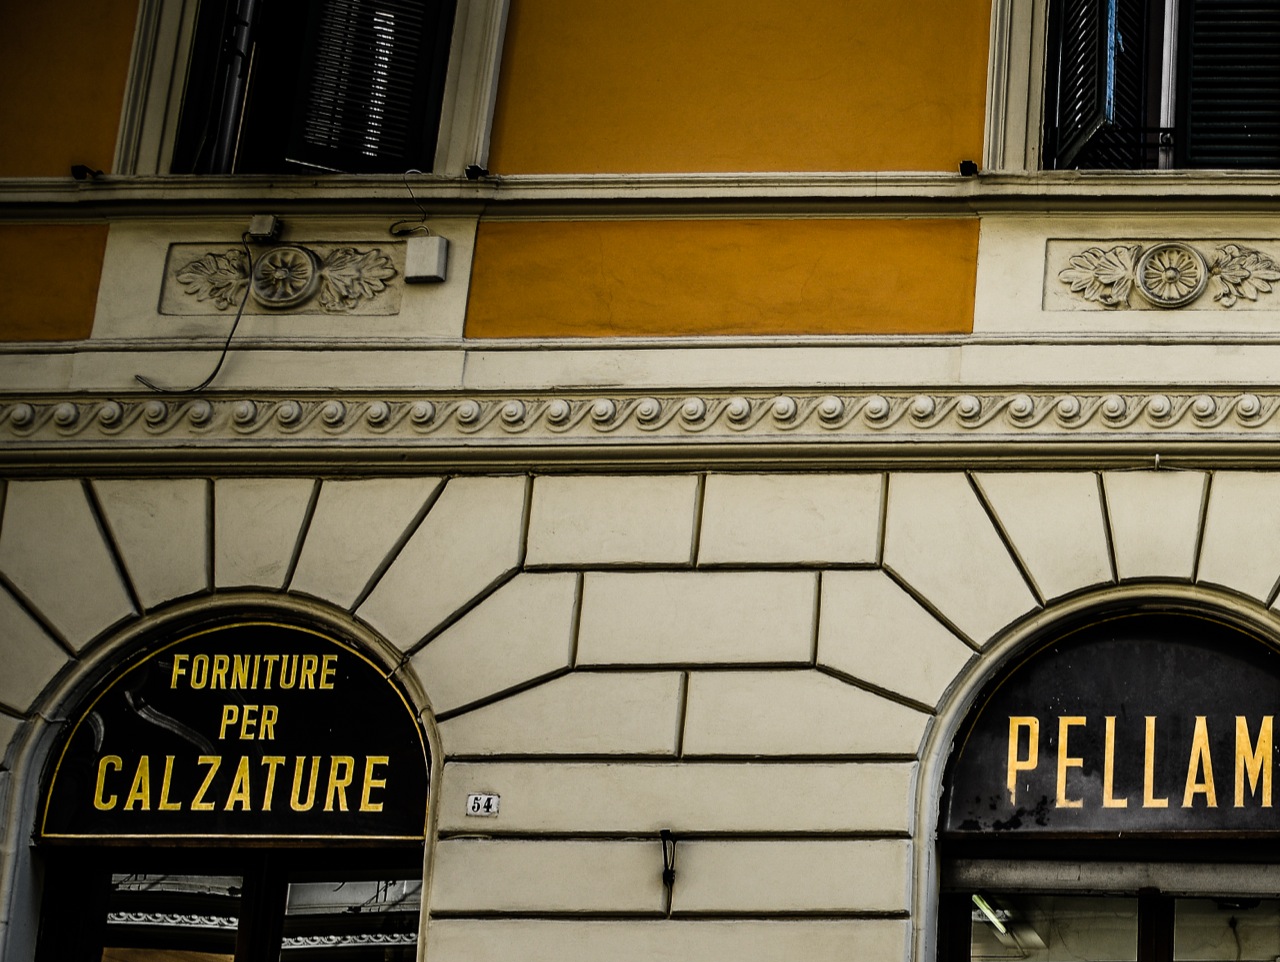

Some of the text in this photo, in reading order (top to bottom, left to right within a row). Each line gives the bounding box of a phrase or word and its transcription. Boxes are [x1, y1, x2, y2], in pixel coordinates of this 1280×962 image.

[170, 654, 338, 690] FORNITURE
[218, 704, 279, 740] PER
[93, 754, 390, 812] CALZATURE
[471, 796, 493, 813] 54
